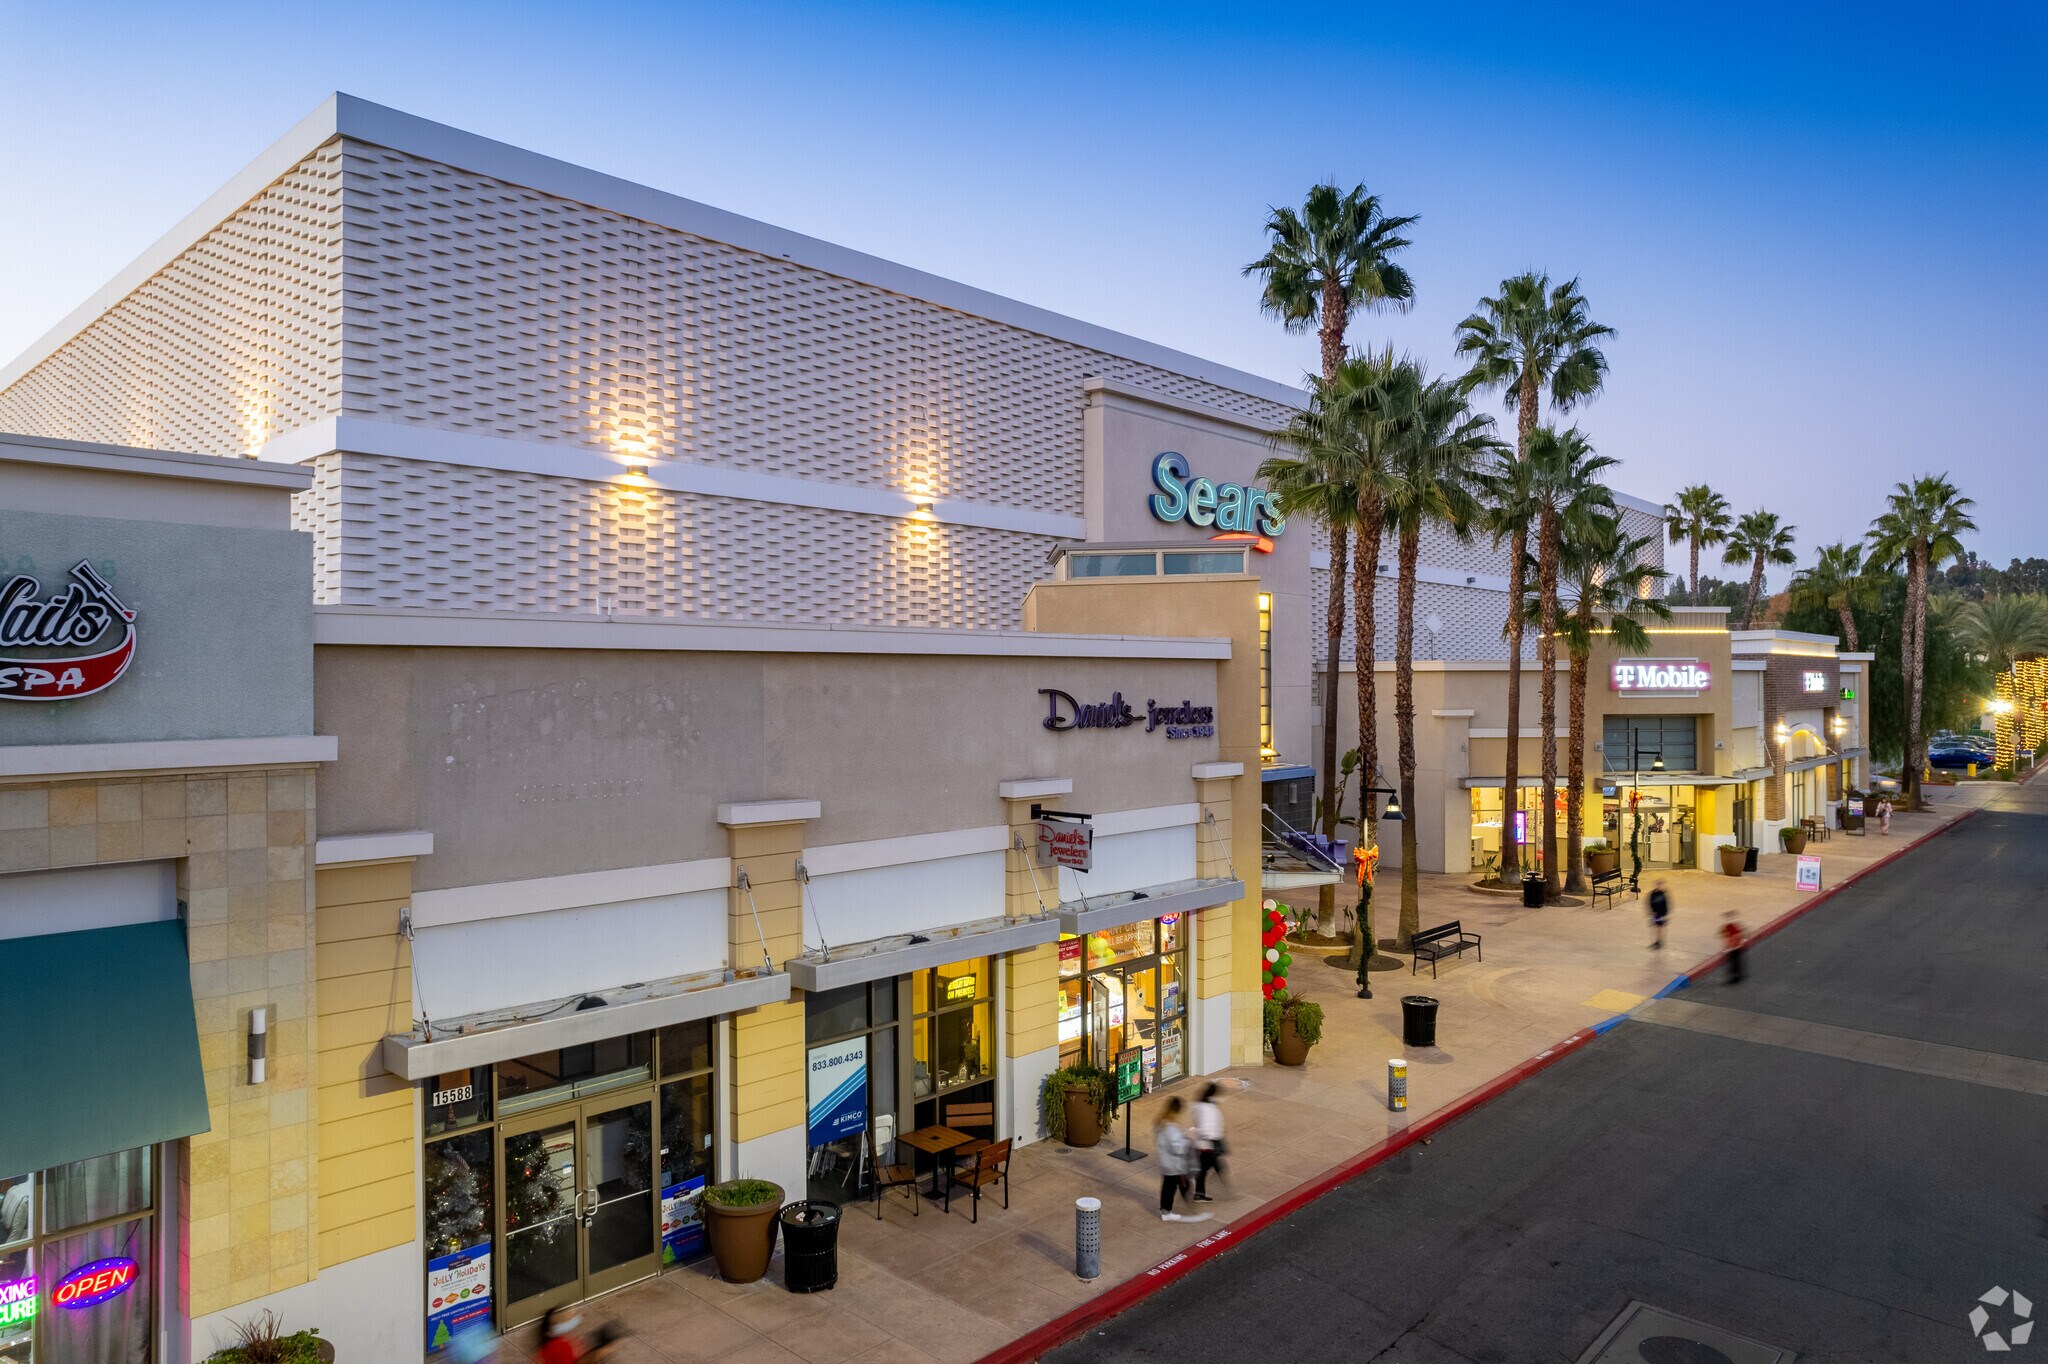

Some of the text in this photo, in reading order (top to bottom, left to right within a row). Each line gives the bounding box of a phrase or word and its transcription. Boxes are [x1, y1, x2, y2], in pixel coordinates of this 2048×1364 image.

[1149, 451, 1285, 537] Sears
[0, 667, 86, 692] SPA
[1637, 665, 1708, 688] Mobile
[1038, 688, 1214, 732] Daniel's jewelers
[1166, 726, 1193, 740] Since
[1037, 823, 1088, 845] Daniel's
[1049, 842, 1088, 859] jewelers
[1162, 1036, 1179, 1047] FREE
[812, 1050, 864, 1072] 833.800.4343
[435, 1086, 471, 1105] 15588
[1146, 1229, 1232, 1276] NO PARKING FIRE LANE
[57, 1265, 129, 1303] OPEN
